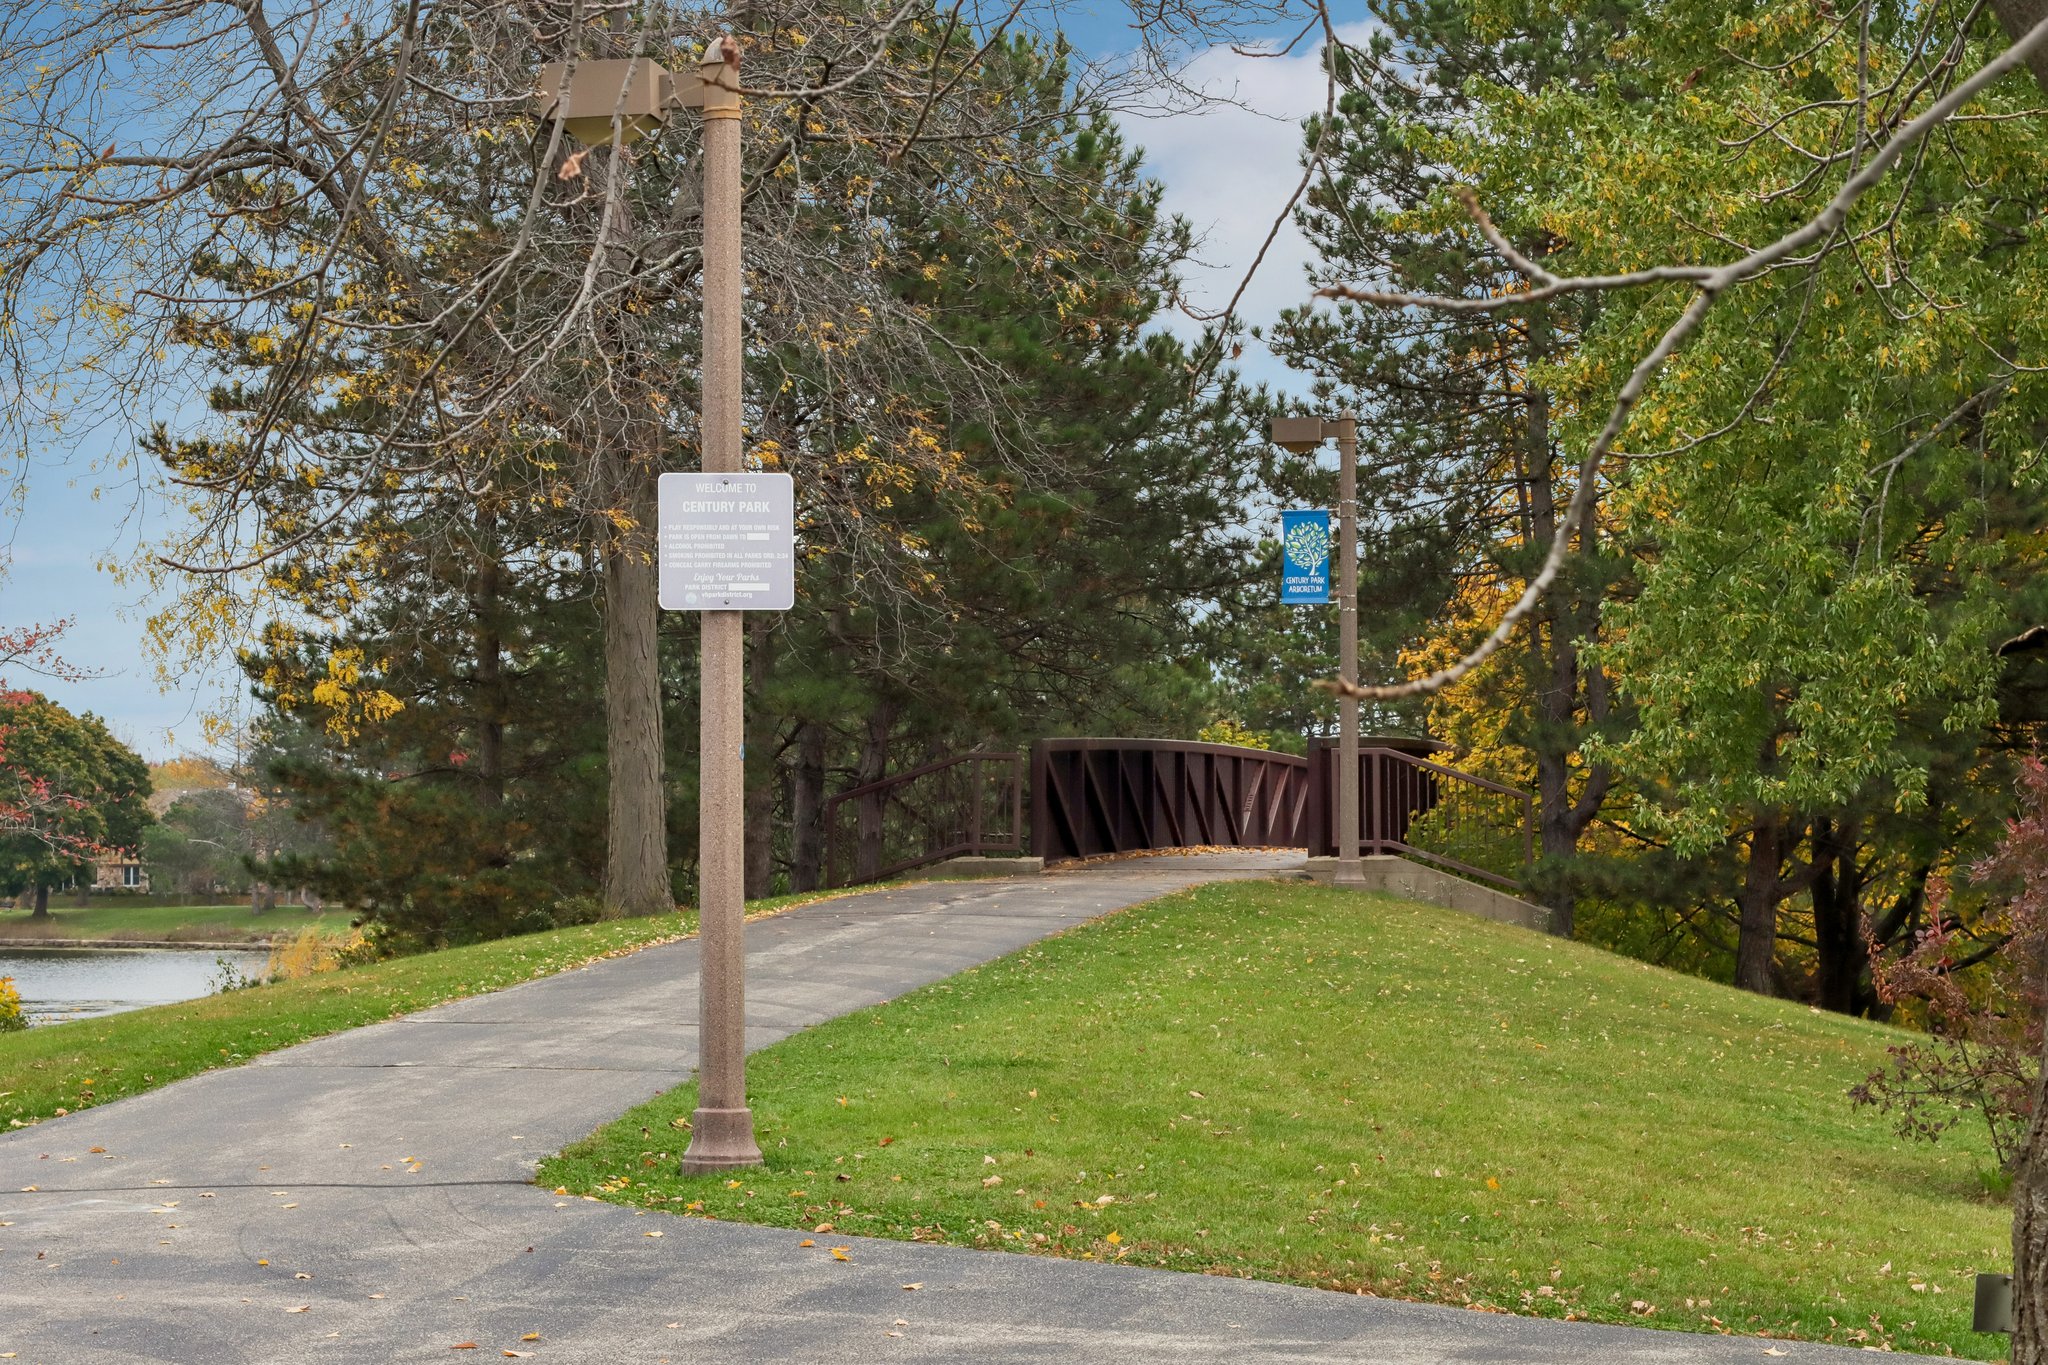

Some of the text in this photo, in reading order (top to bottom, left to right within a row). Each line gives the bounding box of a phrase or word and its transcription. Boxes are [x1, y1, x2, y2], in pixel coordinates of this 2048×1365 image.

[696, 483, 757, 493] WELCOME TO
[683, 501, 770, 513] CENTURY PARK
[694, 573, 760, 583] Enjoy Your Parks
